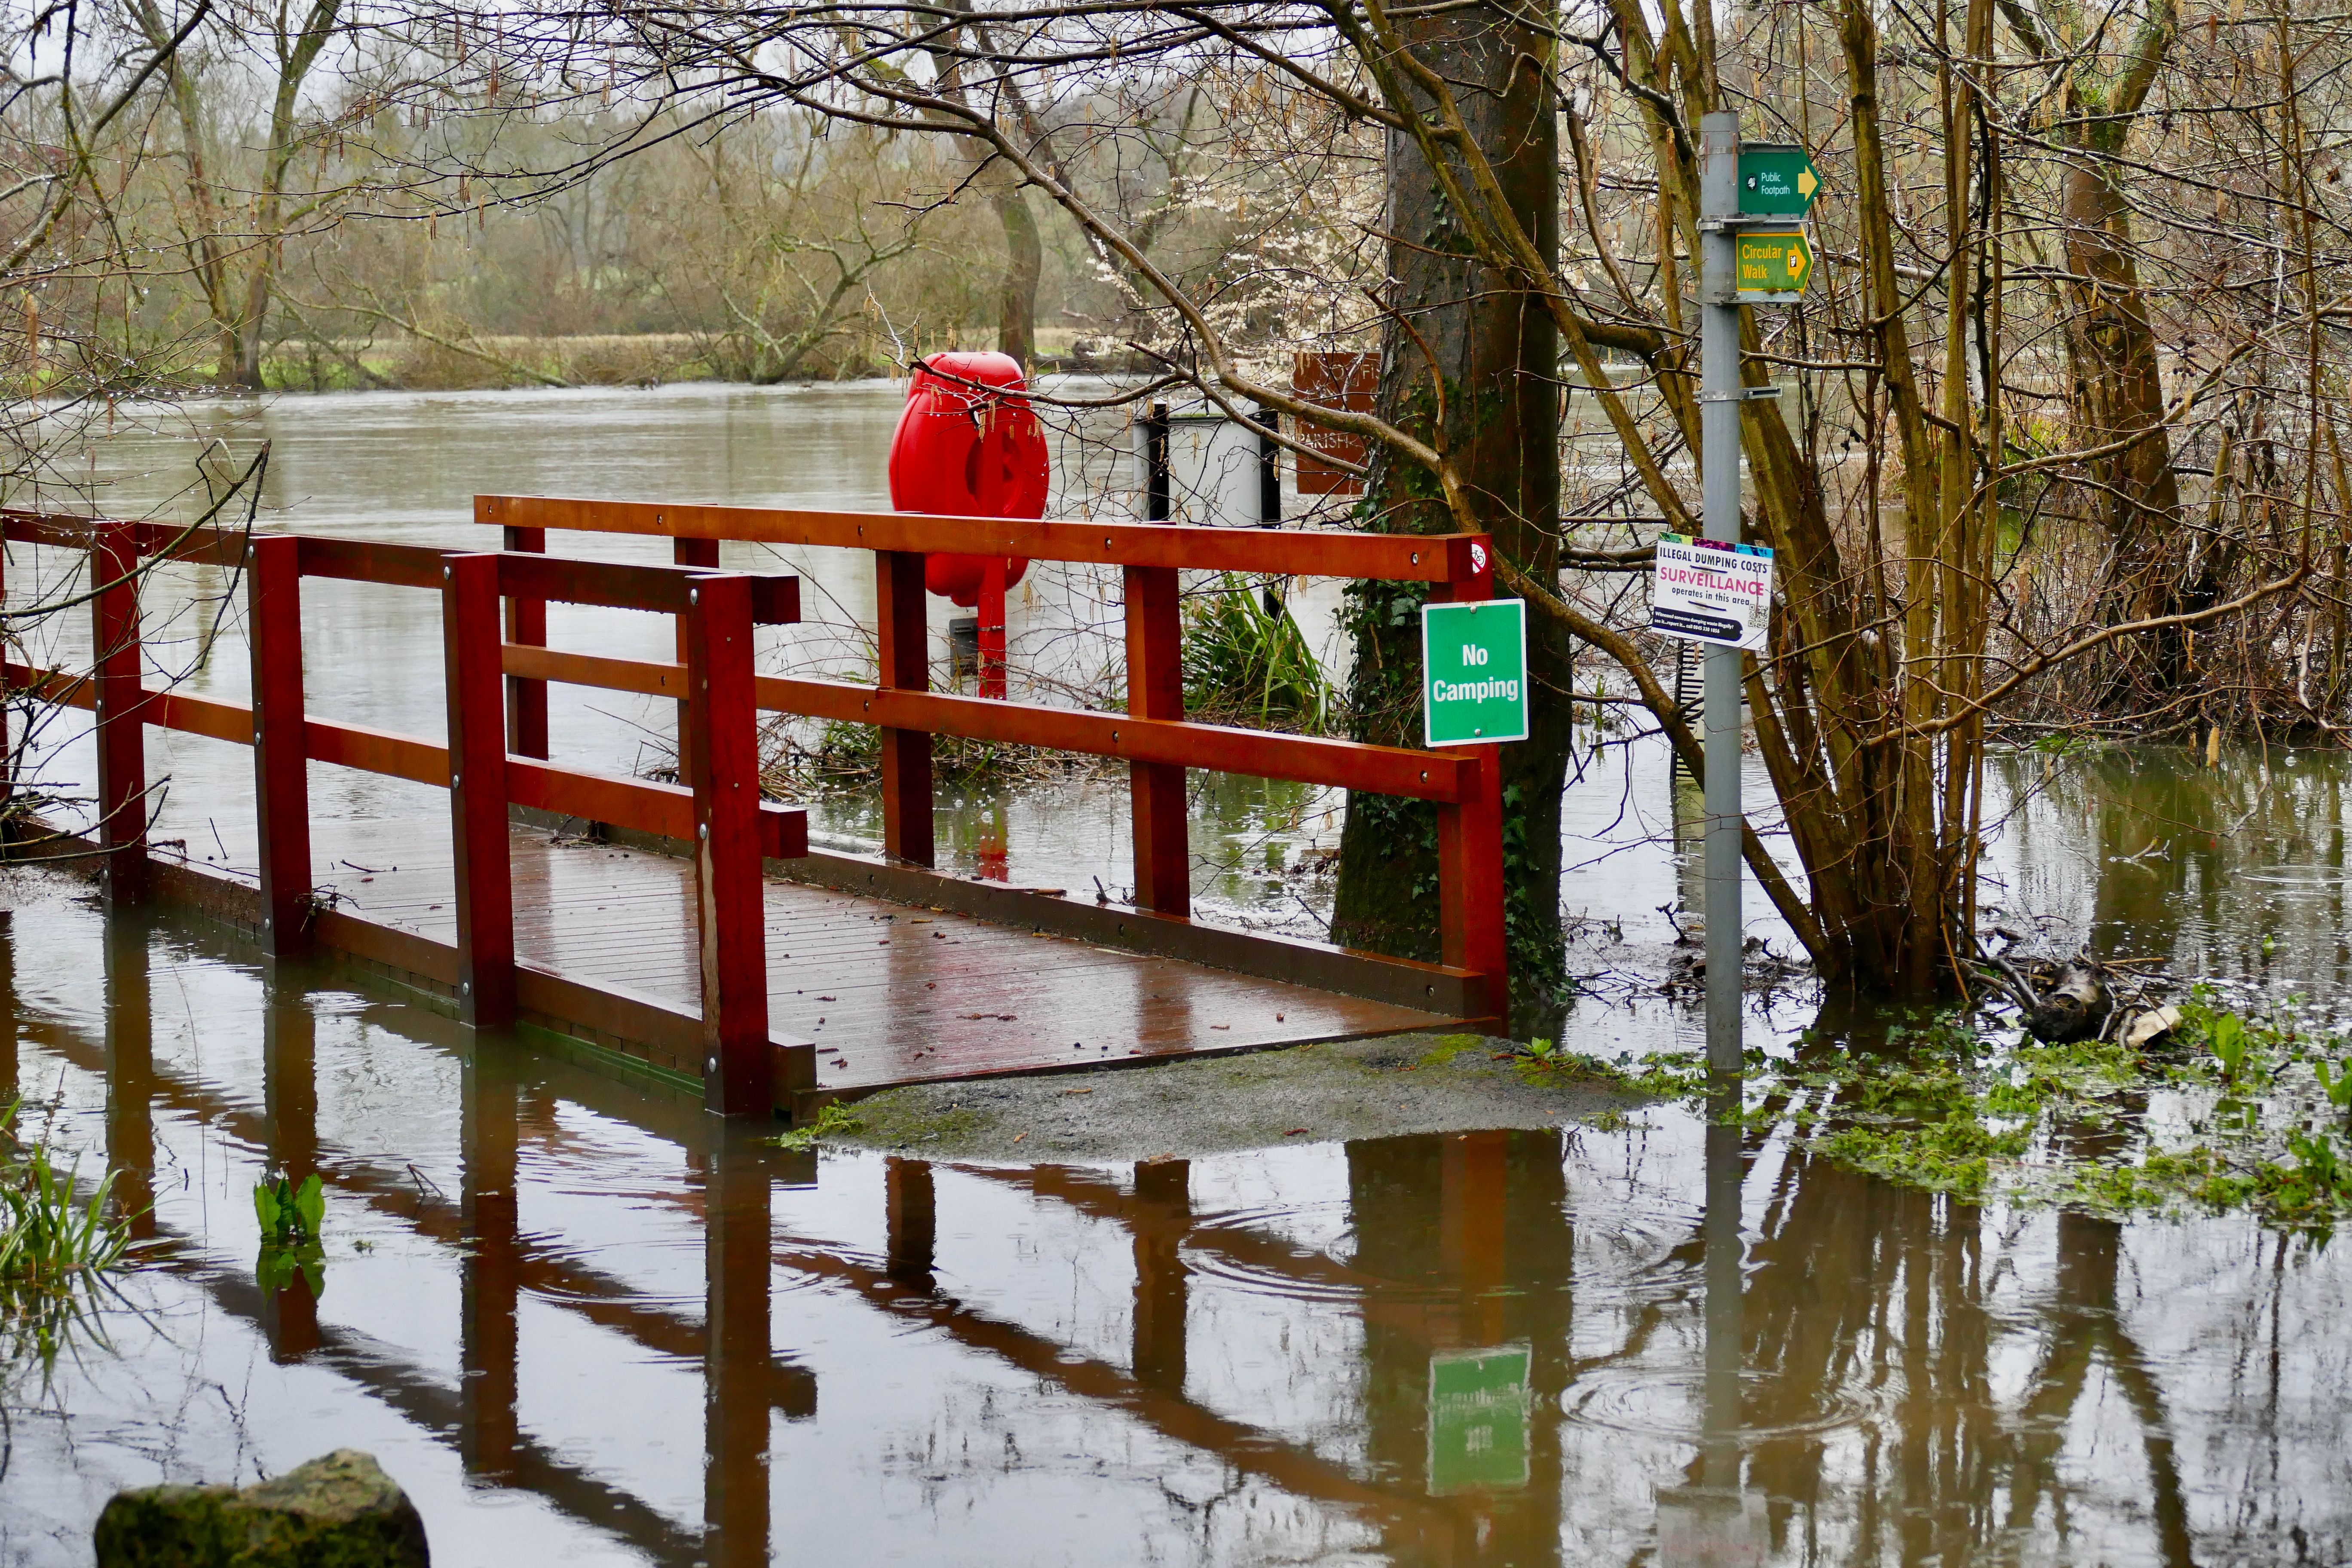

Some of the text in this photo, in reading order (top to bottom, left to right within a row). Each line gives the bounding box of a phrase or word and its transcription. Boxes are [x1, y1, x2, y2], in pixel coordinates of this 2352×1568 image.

[1762, 172, 1781, 181] Public
[1762, 185, 1790, 196] Footpath
[1743, 244, 1782, 259] Circular
[1743, 264, 1767, 279] Walk
[1660, 547, 1767, 573] ILLEGAL DUMPING COSTS
[1660, 567, 1764, 596] SURVEILLANCE
[1672, 587, 1703, 598] operates
[1706, 590, 1712, 599] in
[1715, 592, 1729, 602] this
[1463, 644, 1488, 666] No
[1433, 677, 1518, 703] Camping
